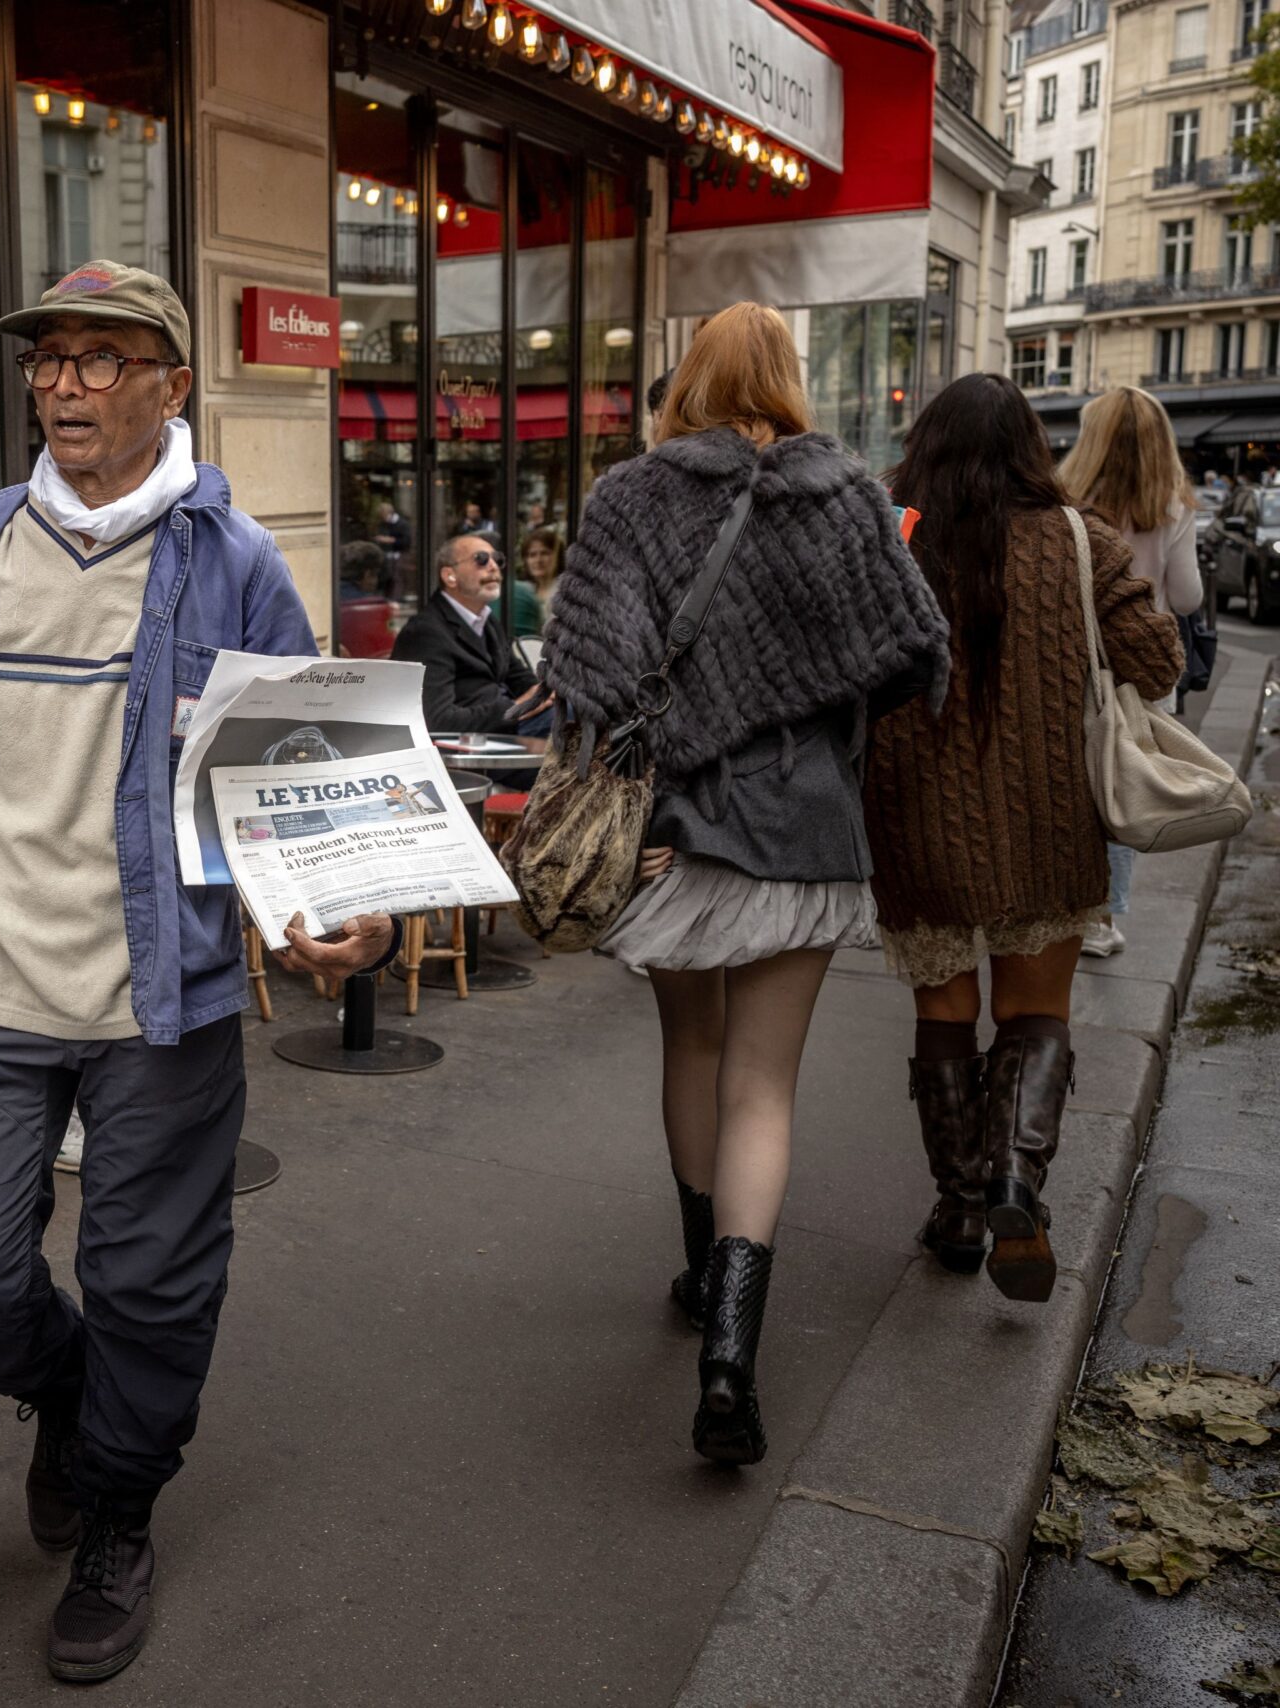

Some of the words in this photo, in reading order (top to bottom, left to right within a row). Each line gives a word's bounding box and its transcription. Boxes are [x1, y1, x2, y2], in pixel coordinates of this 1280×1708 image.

[728, 40, 813, 129] restaurant
[290, 671, 305, 684] The
[305, 671, 326, 684] New
[324, 672, 344, 687] York
[343, 672, 366, 684] Times
[255, 786, 291, 808] LE
[294, 774, 401, 805] FIGARO
[273, 814, 304, 823] ENQUÊTE
[278, 847, 295, 859] Le
[296, 836, 347, 857] tandem
[348, 820, 448, 844] Macron-Lecornu
[285, 860, 295, 871] à
[295, 844, 355, 869] l'épreuve
[357, 842, 374, 852] de
[375, 839, 387, 849] la
[389, 835, 419, 848] crise
